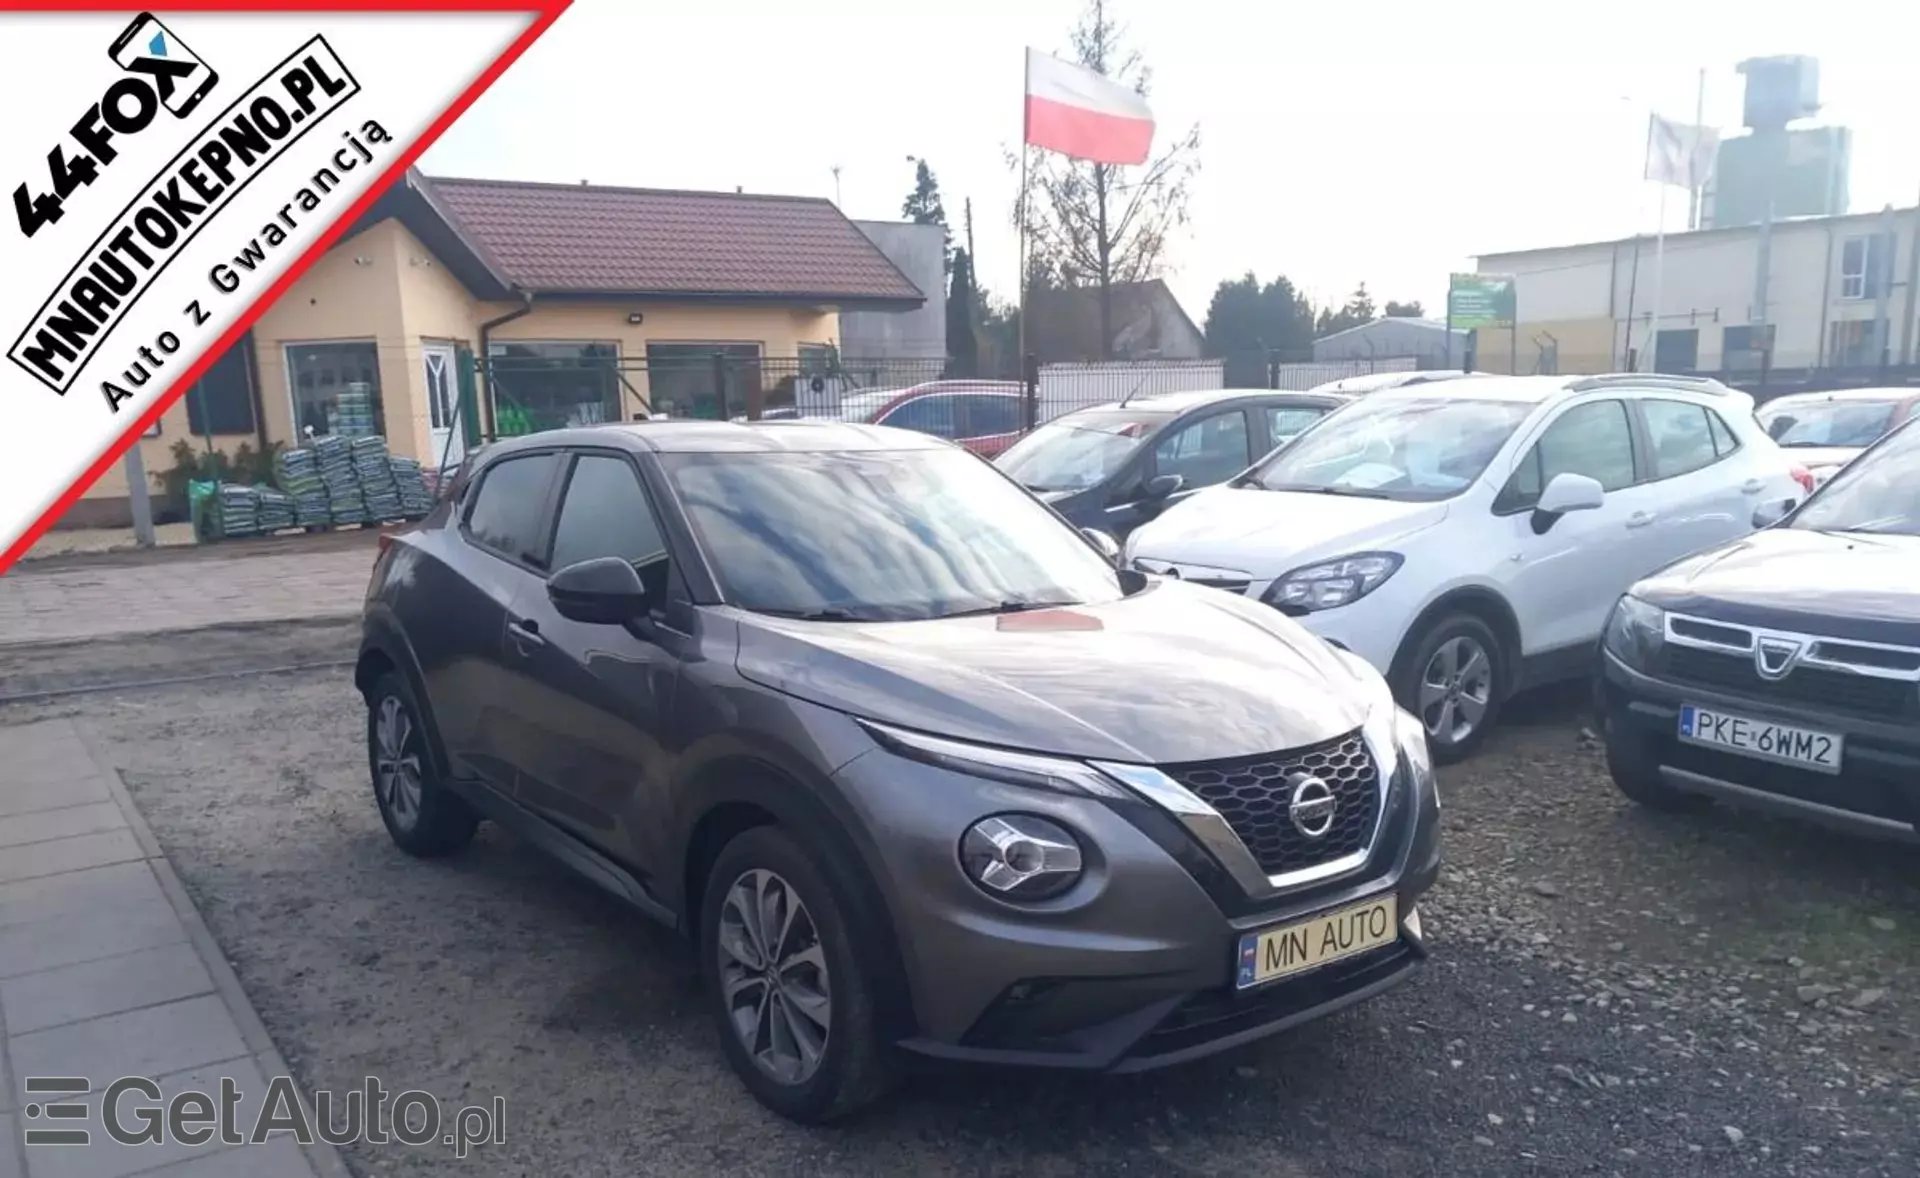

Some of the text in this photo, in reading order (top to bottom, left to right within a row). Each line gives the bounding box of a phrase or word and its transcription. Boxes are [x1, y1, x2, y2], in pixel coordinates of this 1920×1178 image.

[1698, 713, 1832, 764] PKE 6WM2
[1265, 906, 1387, 972] MN AUTO
